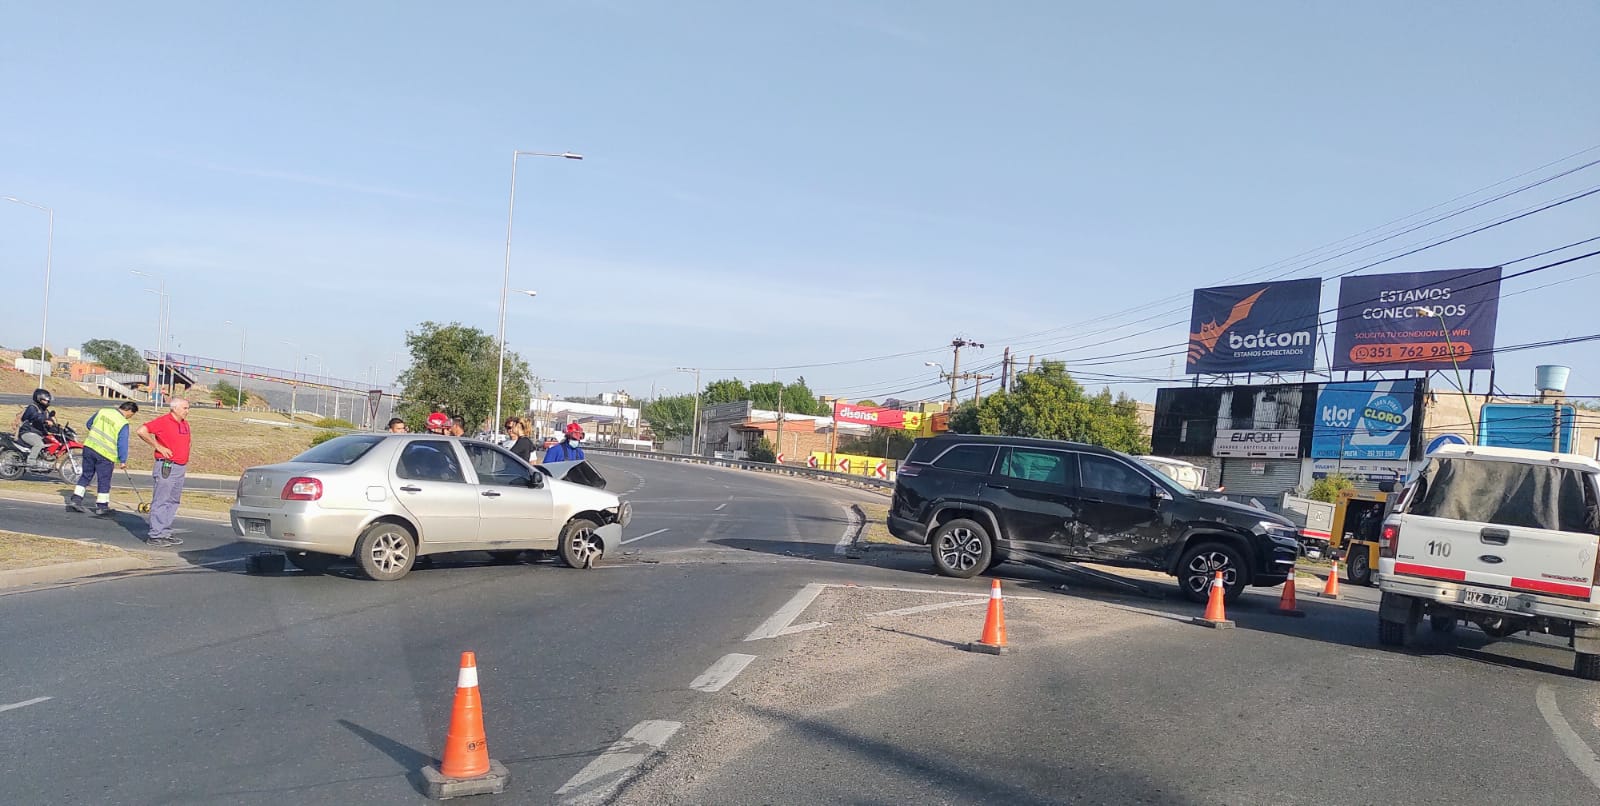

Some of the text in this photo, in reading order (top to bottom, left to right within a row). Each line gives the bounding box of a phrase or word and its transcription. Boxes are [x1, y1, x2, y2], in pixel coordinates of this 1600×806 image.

[1380, 288, 1451, 303] ESTAMOS
[1362, 304, 1467, 320] CONECTADOS
[1229, 329, 1311, 349] batcom
[1233, 348, 1304, 358] ESTAMOS CONECTADOS
[1370, 347, 1392, 358] 351
[1400, 346, 1424, 357] 762
[840, 407, 878, 421] disensa
[1322, 405, 1356, 422] klor
[1364, 408, 1403, 424] CLORO
[1428, 540, 1452, 557] 110
[1466, 591, 1484, 603] HXZ
